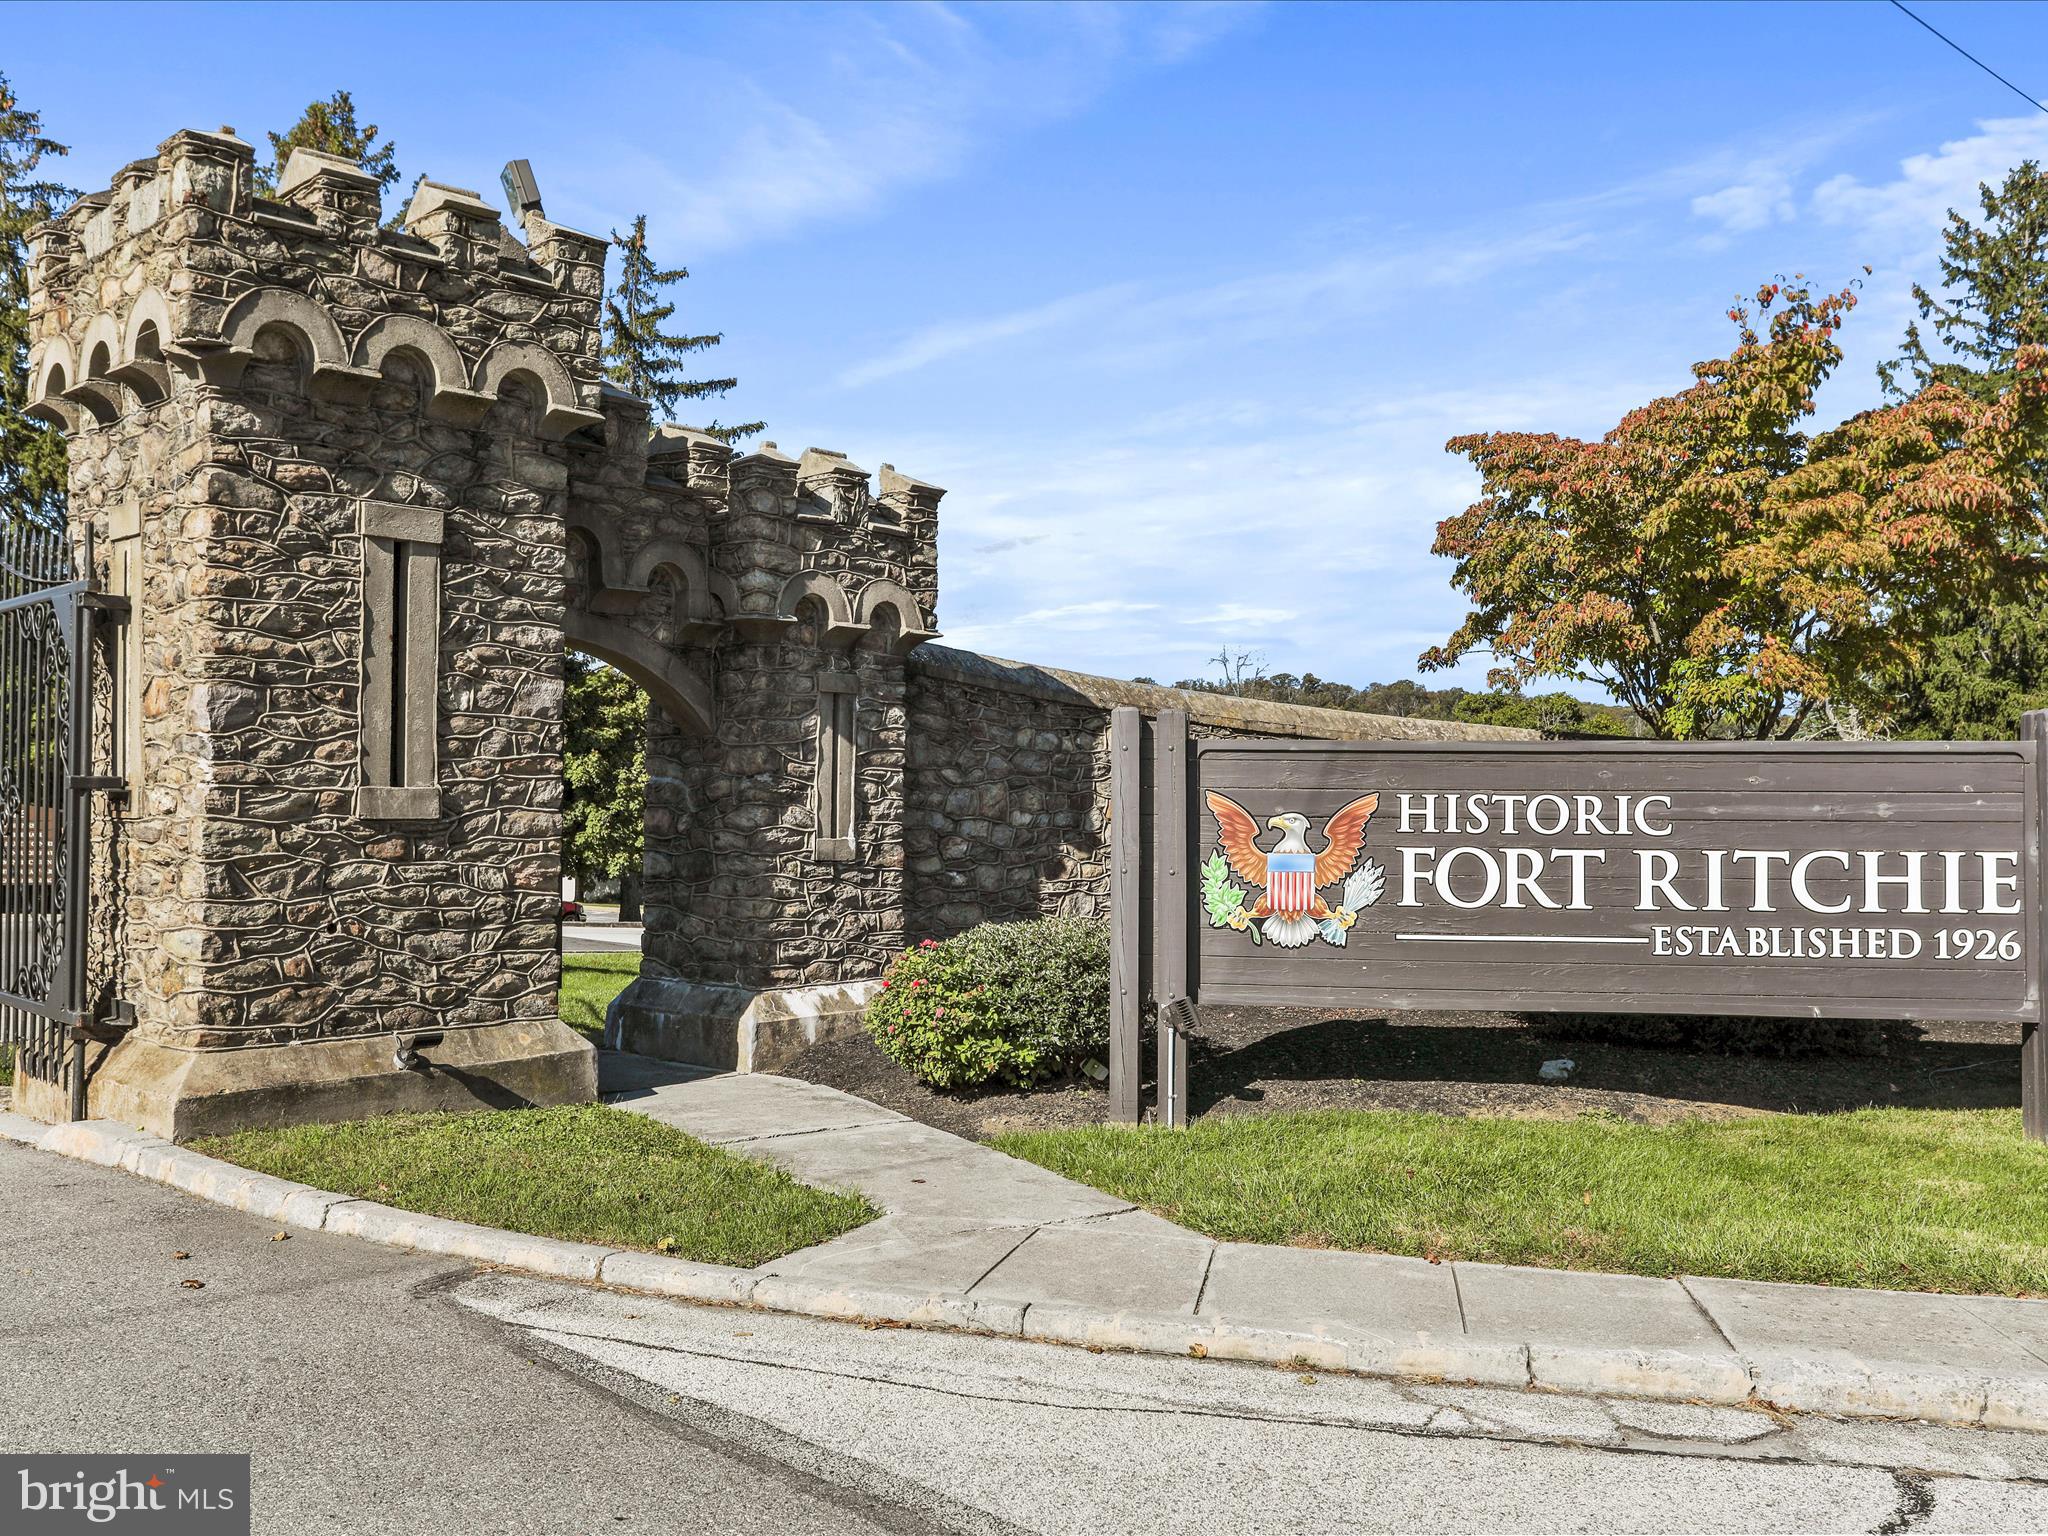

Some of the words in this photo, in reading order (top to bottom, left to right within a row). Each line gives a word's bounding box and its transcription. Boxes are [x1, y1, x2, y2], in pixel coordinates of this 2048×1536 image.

[1396, 793, 1672, 836] HISTORIC
[1395, 846, 1606, 909] FORT
[1632, 849, 2021, 914] RITCHIE
[1651, 926, 1922, 959] ESTABLISHED
[1933, 929, 2022, 960] 1926
